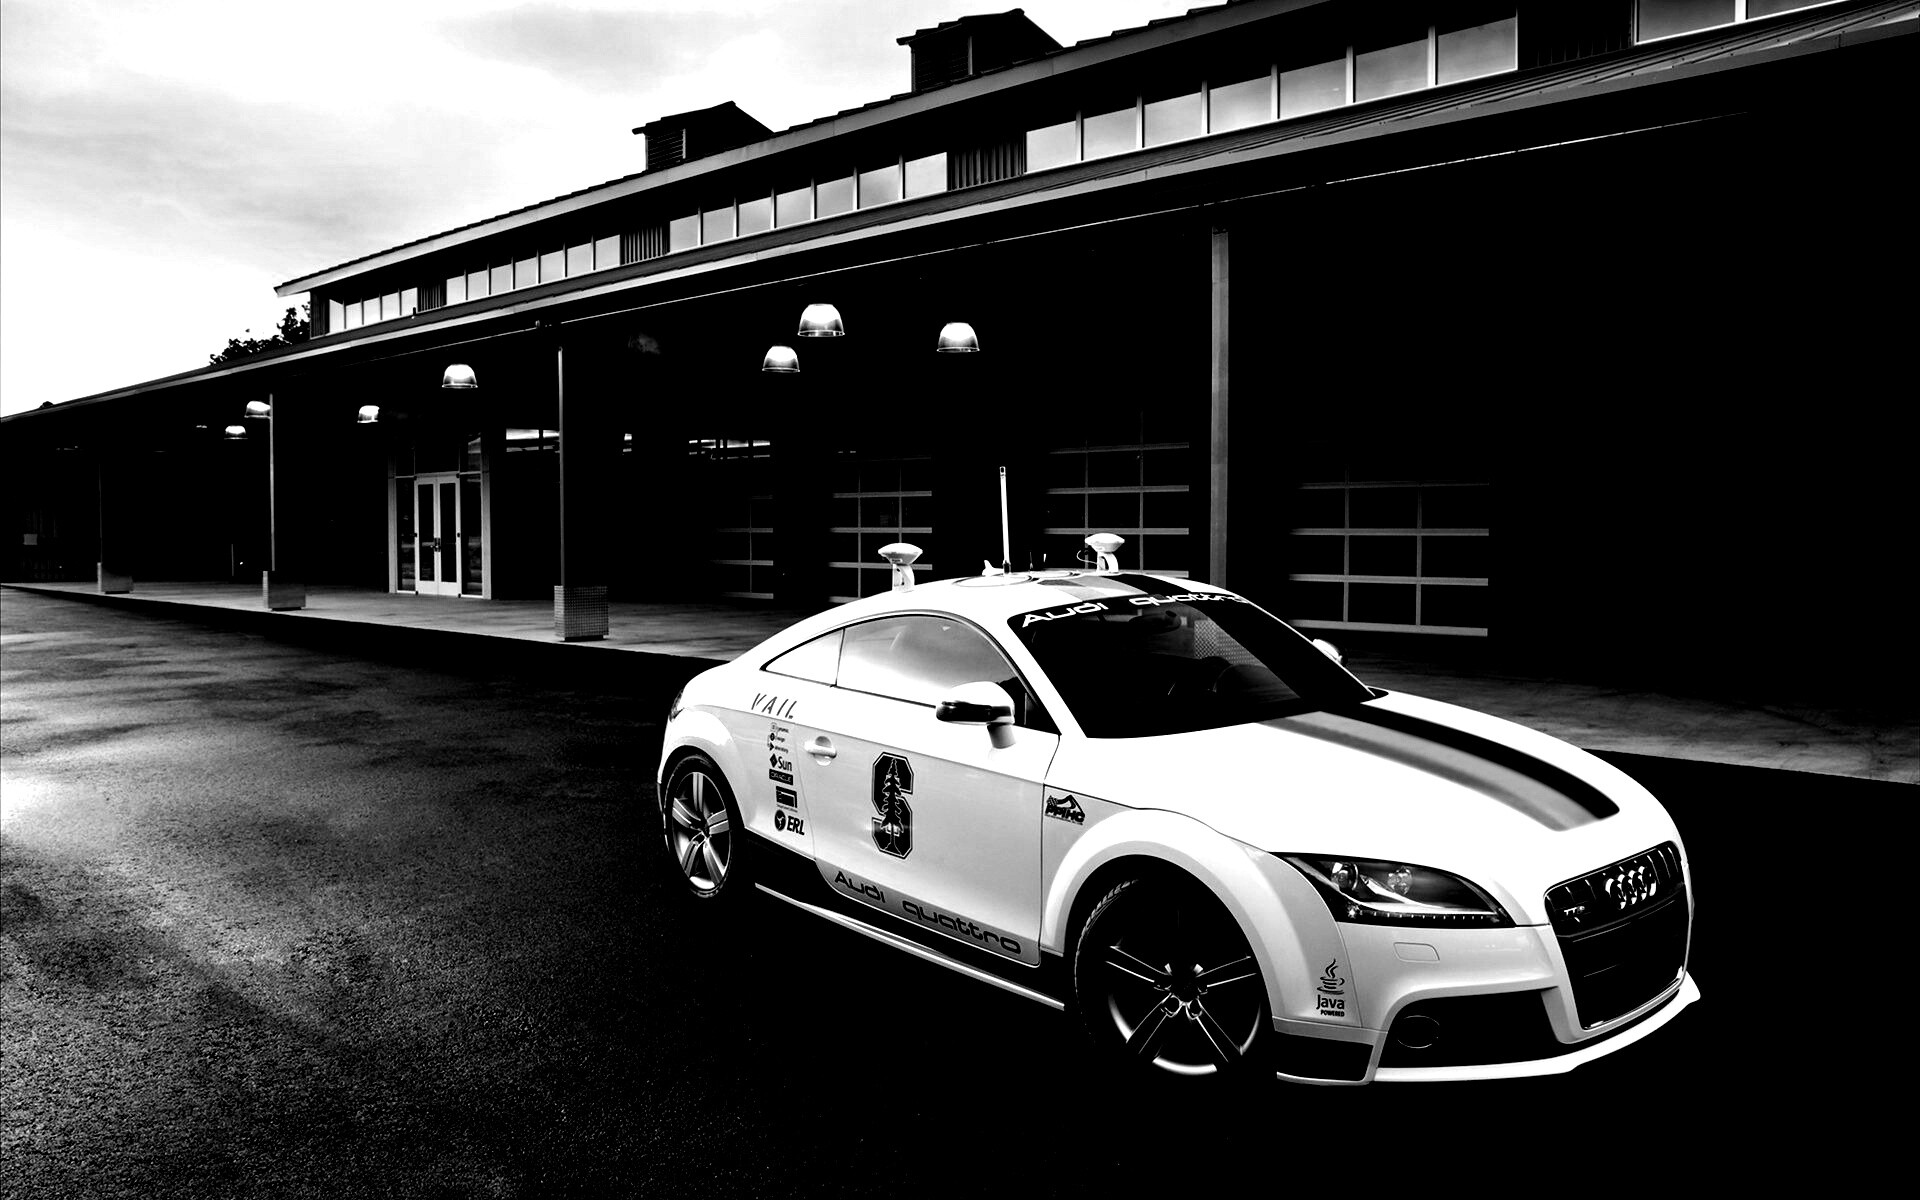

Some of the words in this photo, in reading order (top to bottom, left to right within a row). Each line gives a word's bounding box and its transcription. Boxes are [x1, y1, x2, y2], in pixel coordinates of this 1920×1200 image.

[1022, 602, 1109, 627] Audi
[751, 693, 797, 719] VAIL
[778, 756, 792, 771] Sun
[787, 815, 805, 835] ERL
[834, 871, 886, 903] Audi
[902, 900, 1021, 955] quattro
[1316, 994, 1345, 1010] Java
